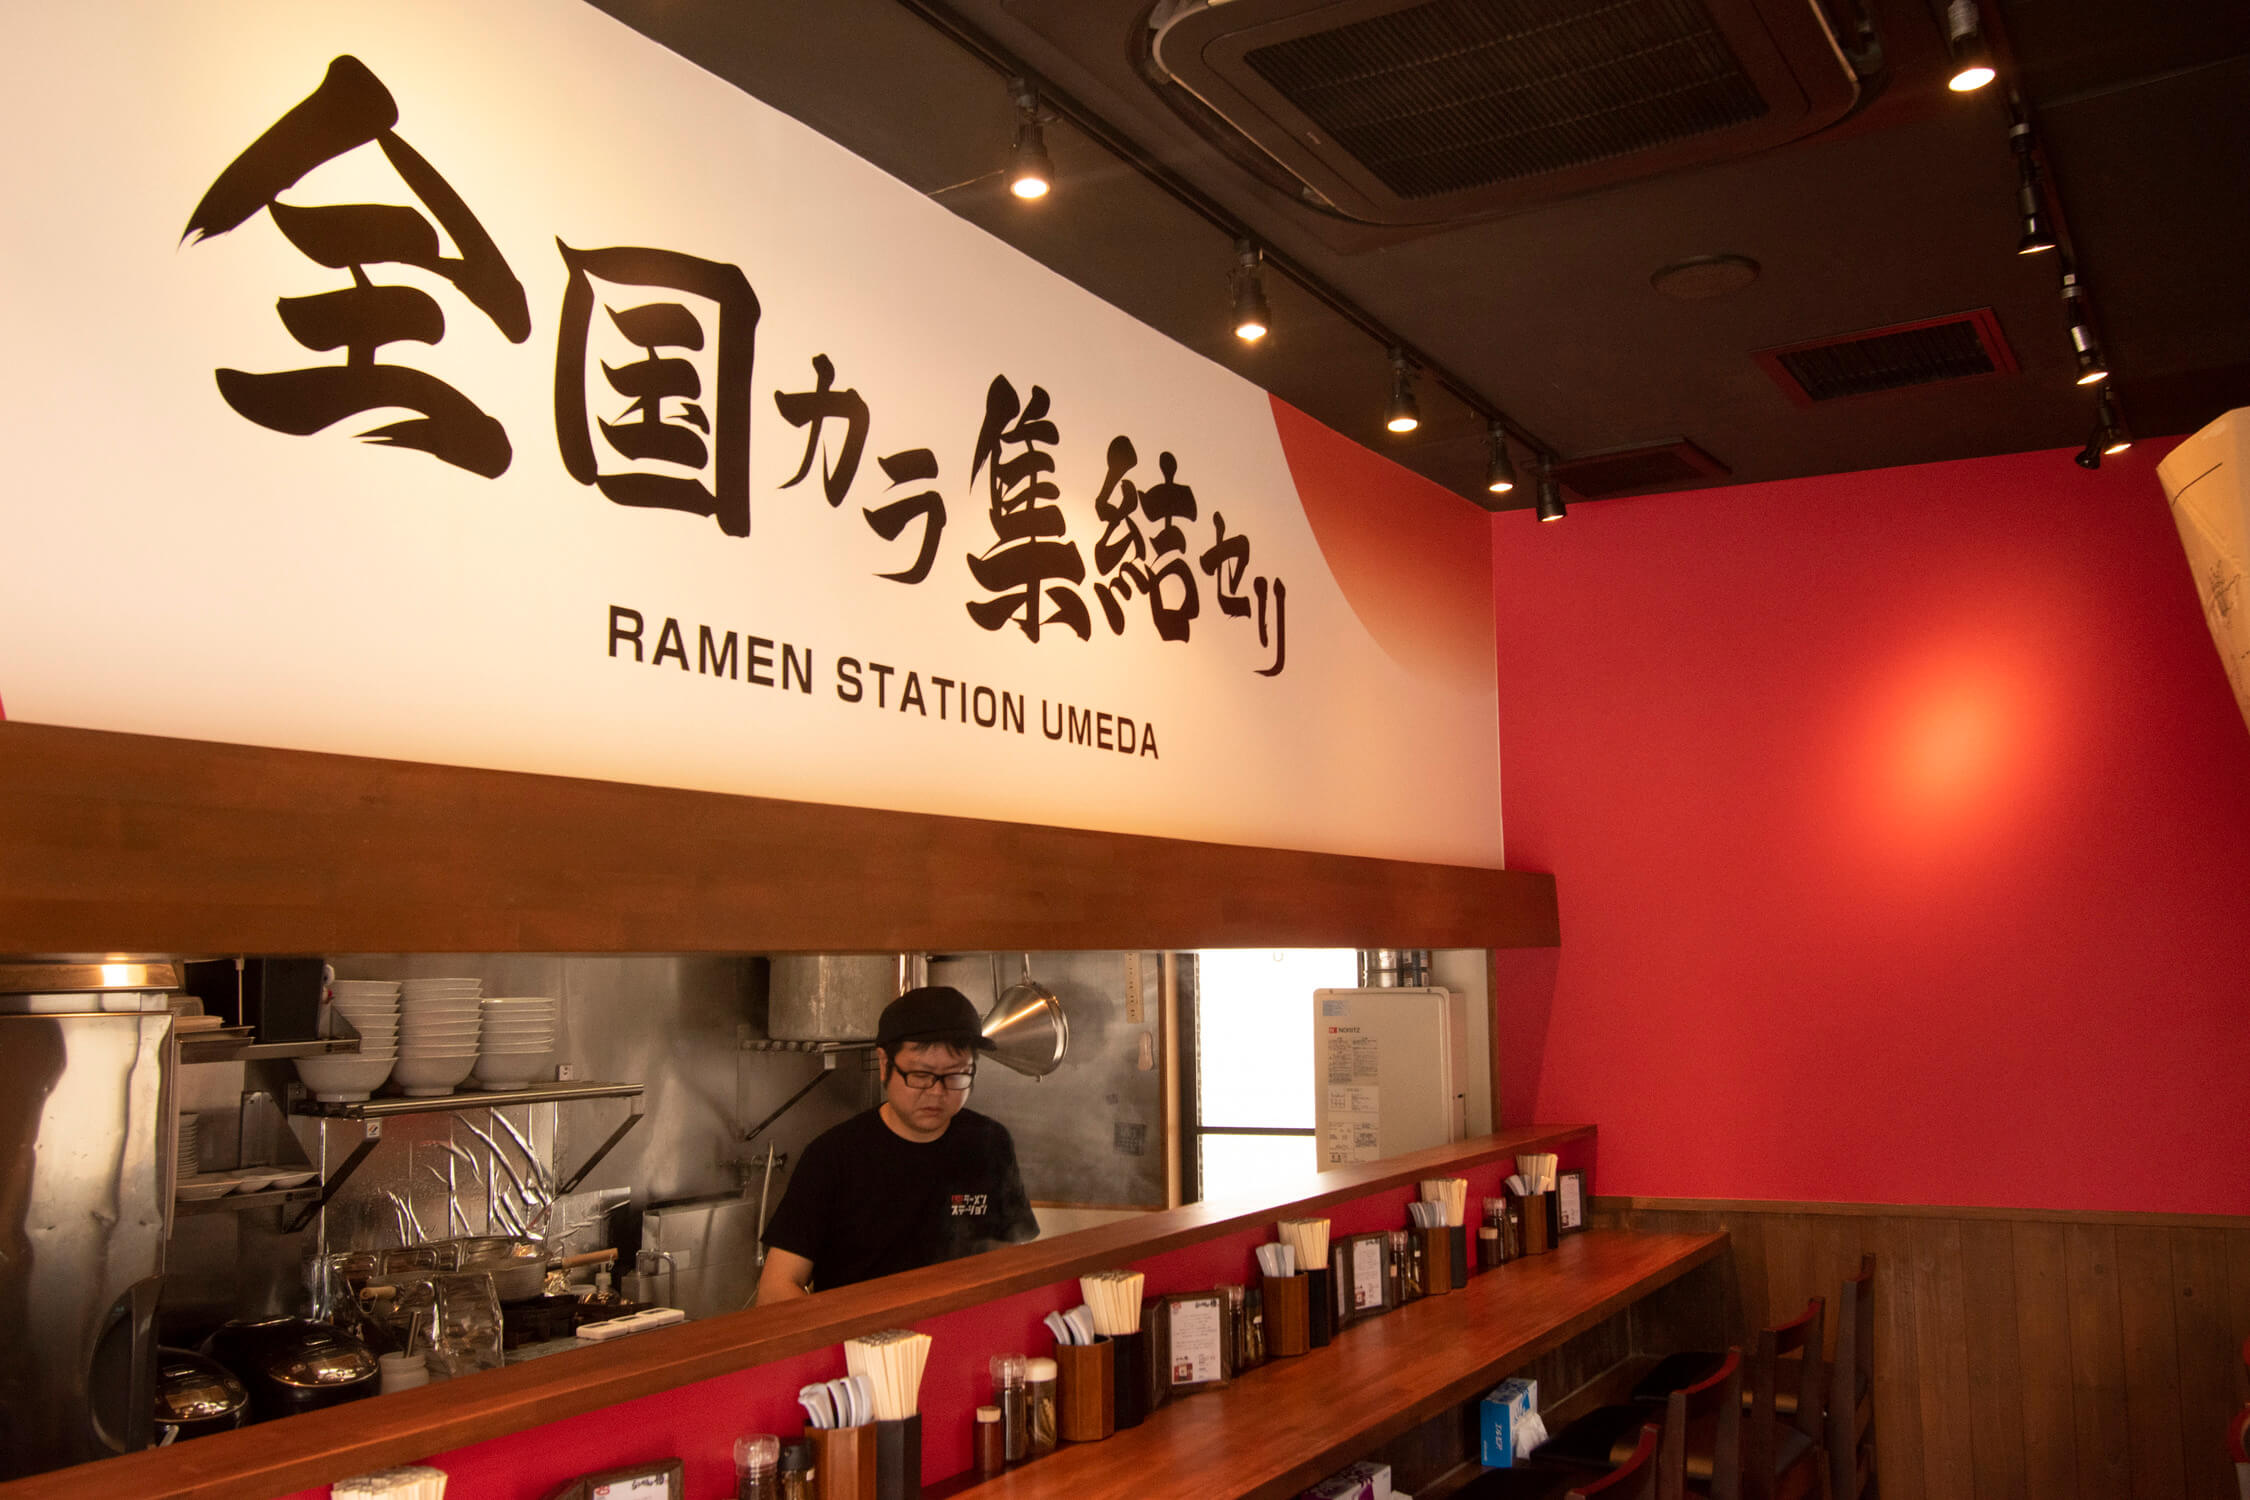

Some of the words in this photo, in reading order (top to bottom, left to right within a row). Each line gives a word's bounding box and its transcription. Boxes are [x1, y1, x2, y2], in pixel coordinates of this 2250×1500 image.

[608, 604, 812, 695] RAMEN
[836, 655, 1026, 735] STATION
[1042, 700, 1159, 760] UMEDA
[951, 1204, 988, 1216] ステーション
